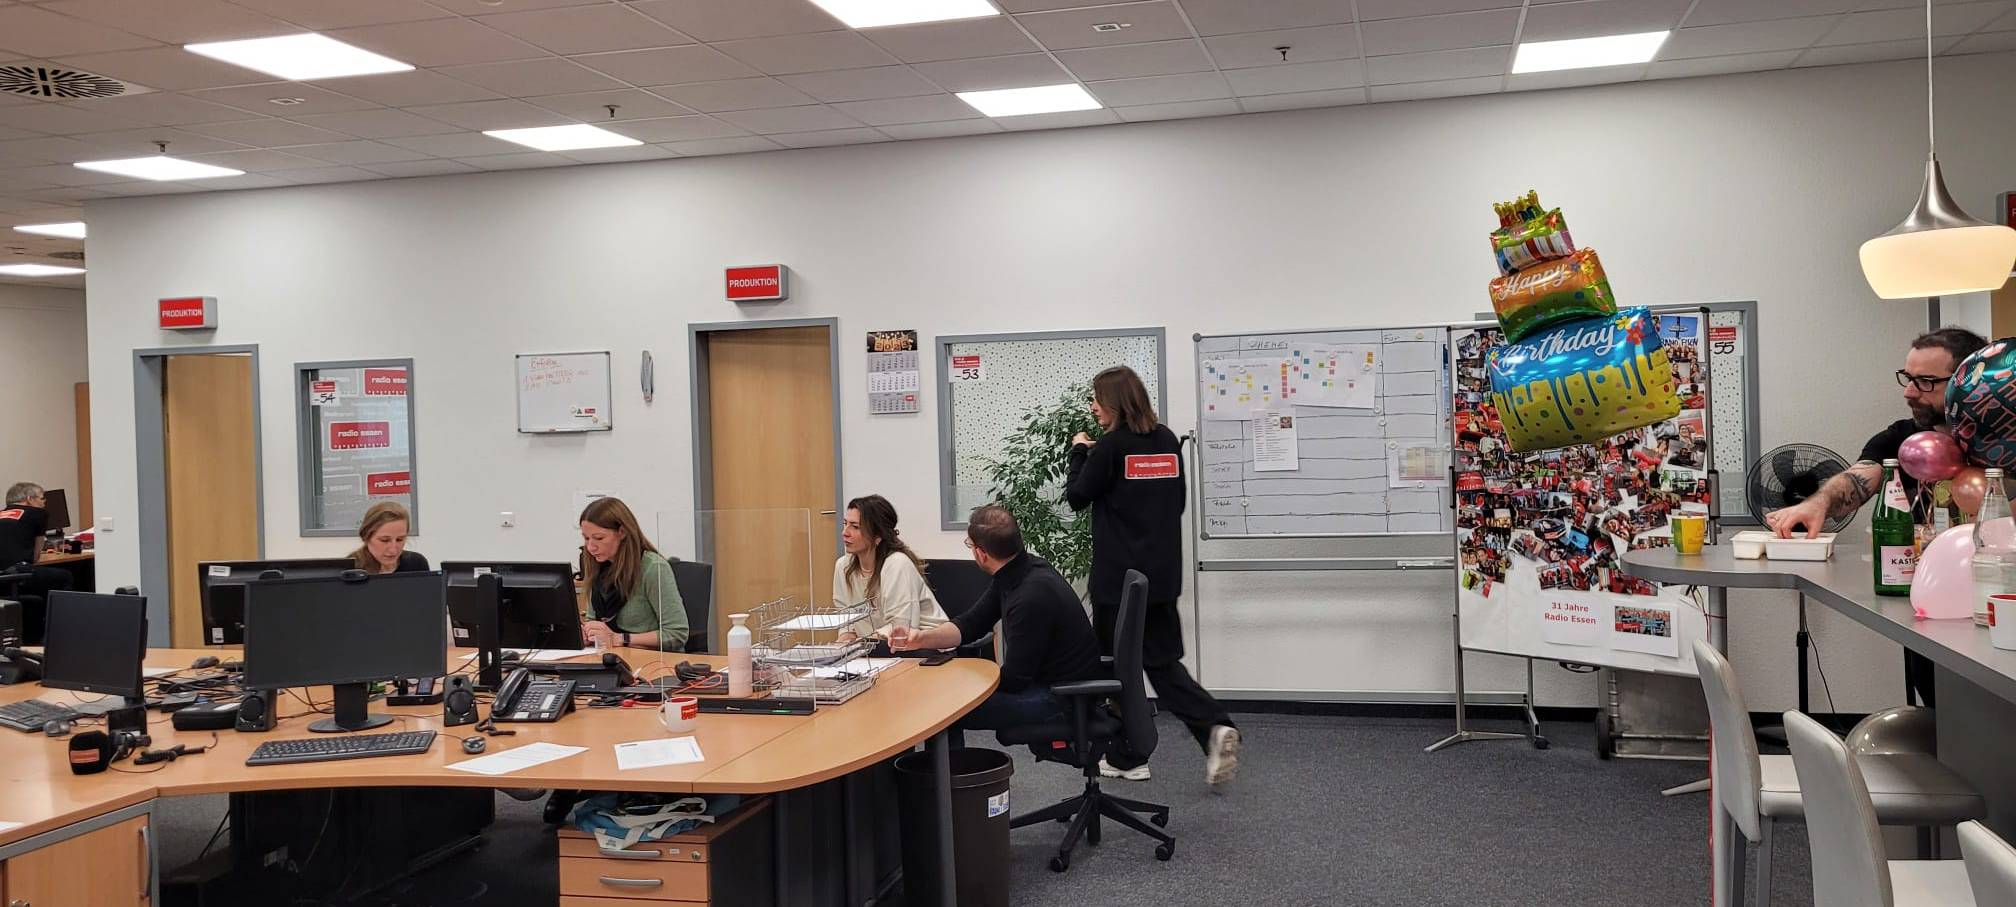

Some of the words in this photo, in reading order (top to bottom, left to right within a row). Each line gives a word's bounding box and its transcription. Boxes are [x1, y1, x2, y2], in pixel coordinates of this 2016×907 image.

[729, 277, 778, 288] PRODUKTION
[1498, 263, 1569, 300] Happy
[161, 308, 203, 318] PRODUKTION
[1498, 324, 1621, 376] Birthday
[338, 430, 359, 438] radio
[374, 479, 394, 488] radio
[1551, 602, 1561, 610] 31
[1564, 603, 1589, 612] Jahre
[1544, 612, 1569, 622] Radio
[1571, 615, 1596, 624] Essen
